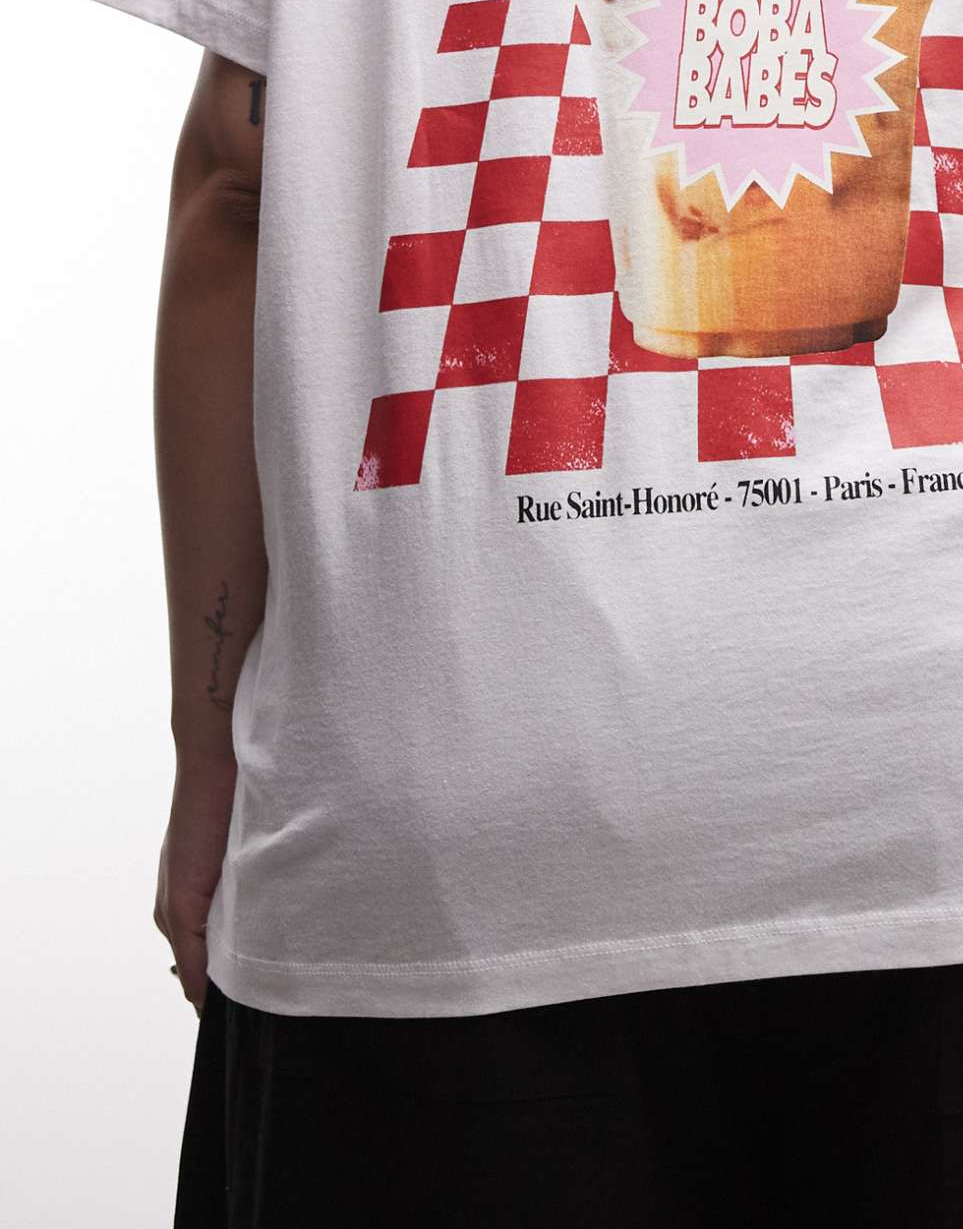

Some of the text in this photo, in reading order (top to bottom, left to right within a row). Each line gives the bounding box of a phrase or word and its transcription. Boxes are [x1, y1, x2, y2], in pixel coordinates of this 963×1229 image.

[673, 52, 839, 130] BABES
[517, 495, 562, 523] Rue
[566, 485, 718, 520] Saint-Honoré
[737, 477, 803, 507] 75001
[825, 472, 883, 502] Paris
